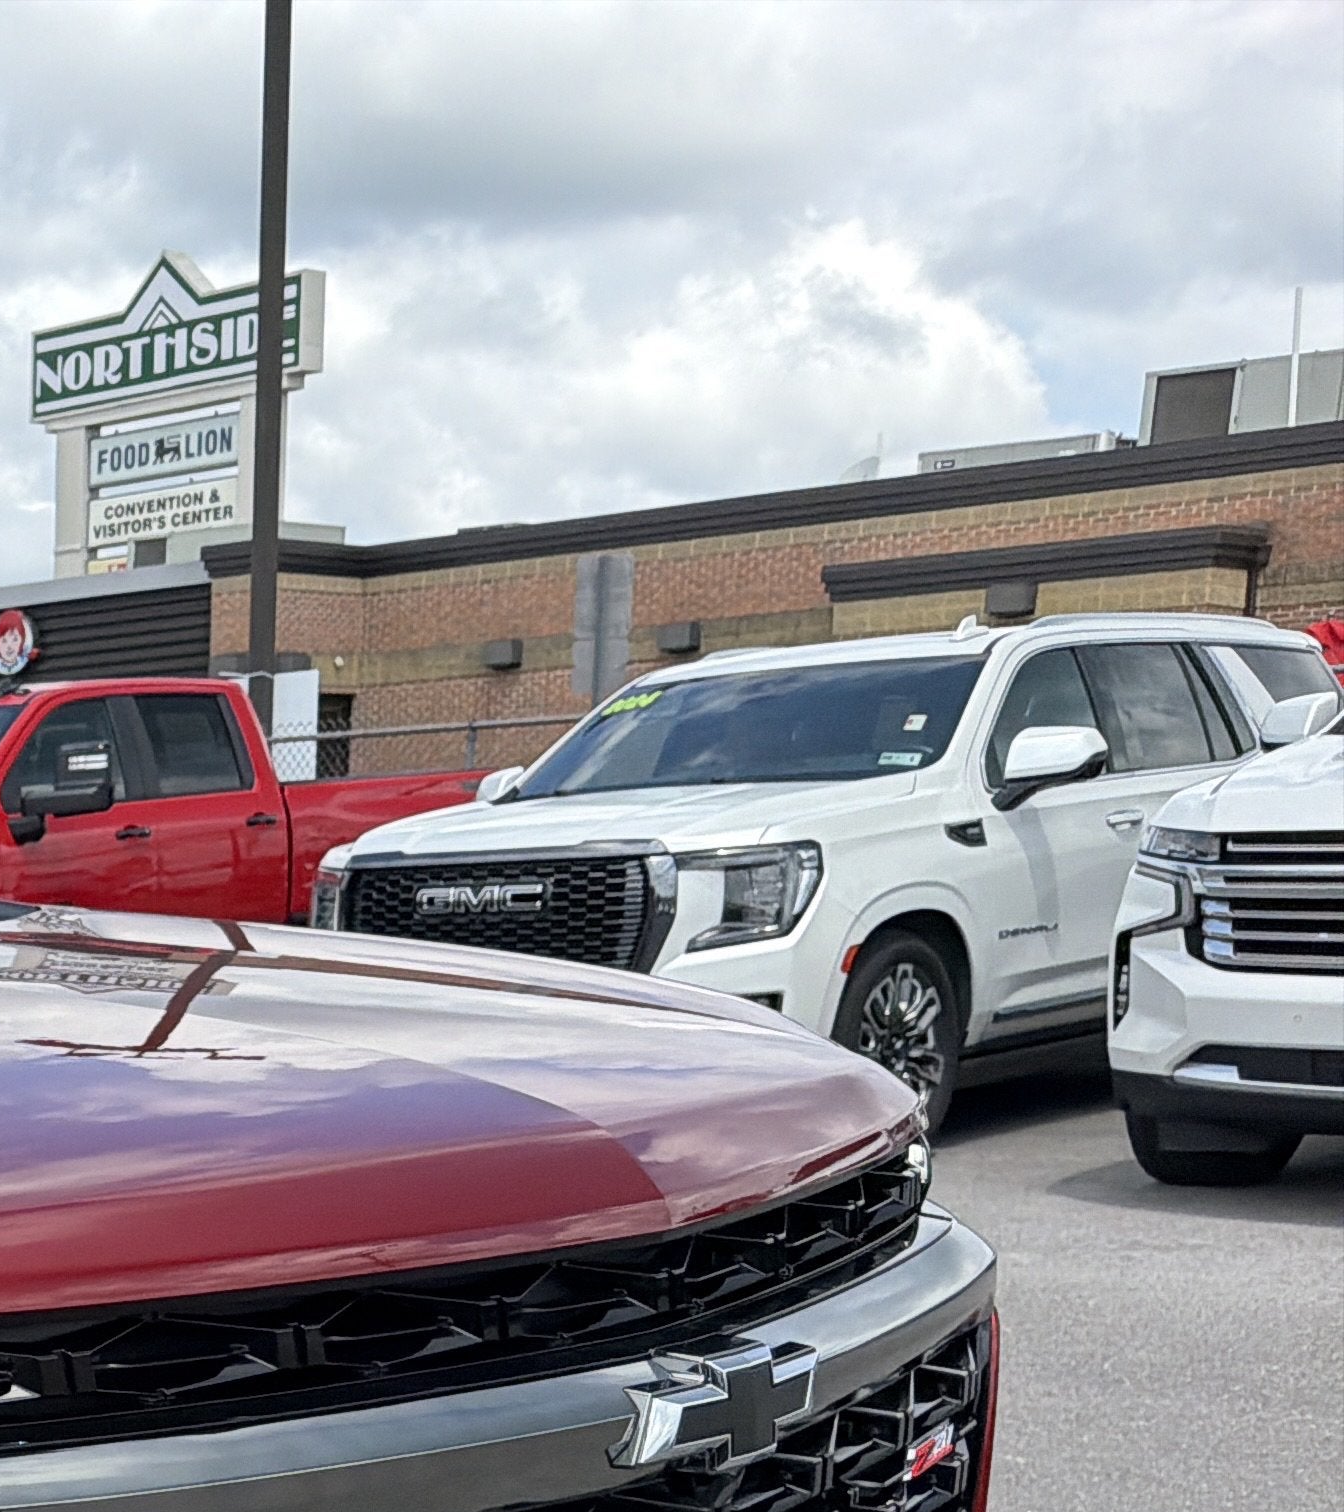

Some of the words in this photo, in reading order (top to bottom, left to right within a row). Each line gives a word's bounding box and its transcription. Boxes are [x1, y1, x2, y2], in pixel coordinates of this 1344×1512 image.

[97, 442, 149, 475] FOOD
[185, 426, 233, 458] LION
[103, 491, 204, 521] CONVENTION
[208, 488, 220, 505] &
[92, 517, 167, 540] VISITOR'S
[170, 504, 234, 528] CENTER
[415, 884, 544, 915] GMC
